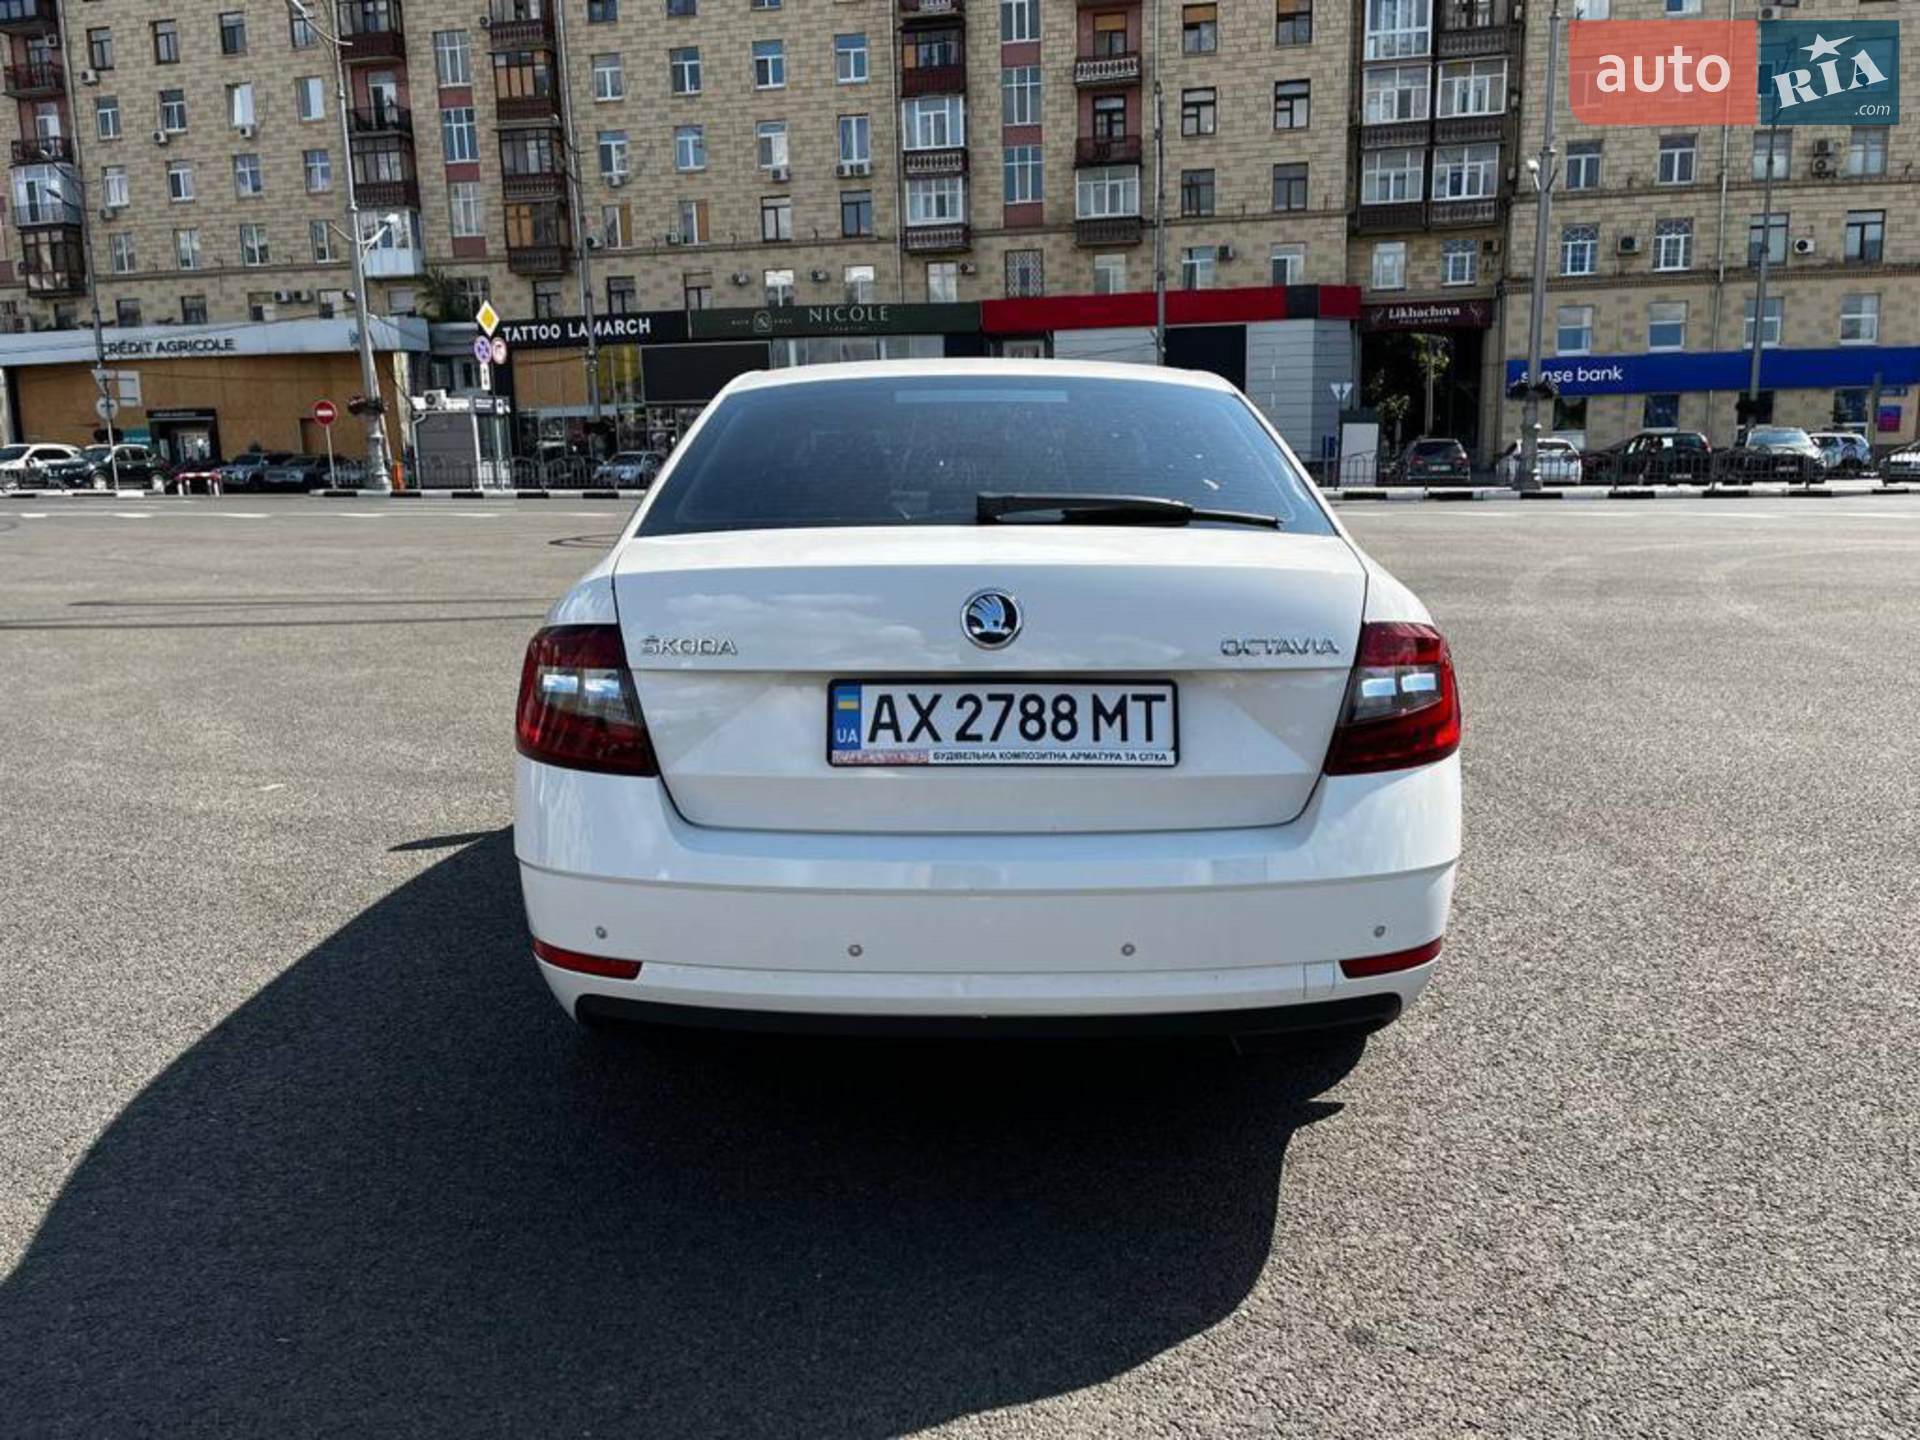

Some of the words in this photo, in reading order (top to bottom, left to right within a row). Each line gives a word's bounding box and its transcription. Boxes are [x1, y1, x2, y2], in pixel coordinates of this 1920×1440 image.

[809, 305, 890, 323] NICOLE
[1388, 305, 1460, 319] Likhachova
[502, 323, 561, 342] TATTOO
[155, 338, 237, 353] AGRICOLE
[1520, 370, 1574, 384] snse
[1577, 365, 1623, 382] bank
[642, 634, 738, 656] ŠKODA
[1219, 638, 1340, 656] OCTAVIA
[867, 693, 942, 744] AX
[955, 692, 1078, 744] 2788
[1092, 693, 1167, 743] MT
[836, 727, 859, 744] UA
[933, 751, 997, 761] БУДІВЕЛЬНА
[999, 751, 1068, 761] КОМПОЗИТНА
[1070, 751, 1122, 761] АРМАТУРА
[1124, 752, 1137, 761] ТА
[1138, 752, 1168, 762] СІТКА
